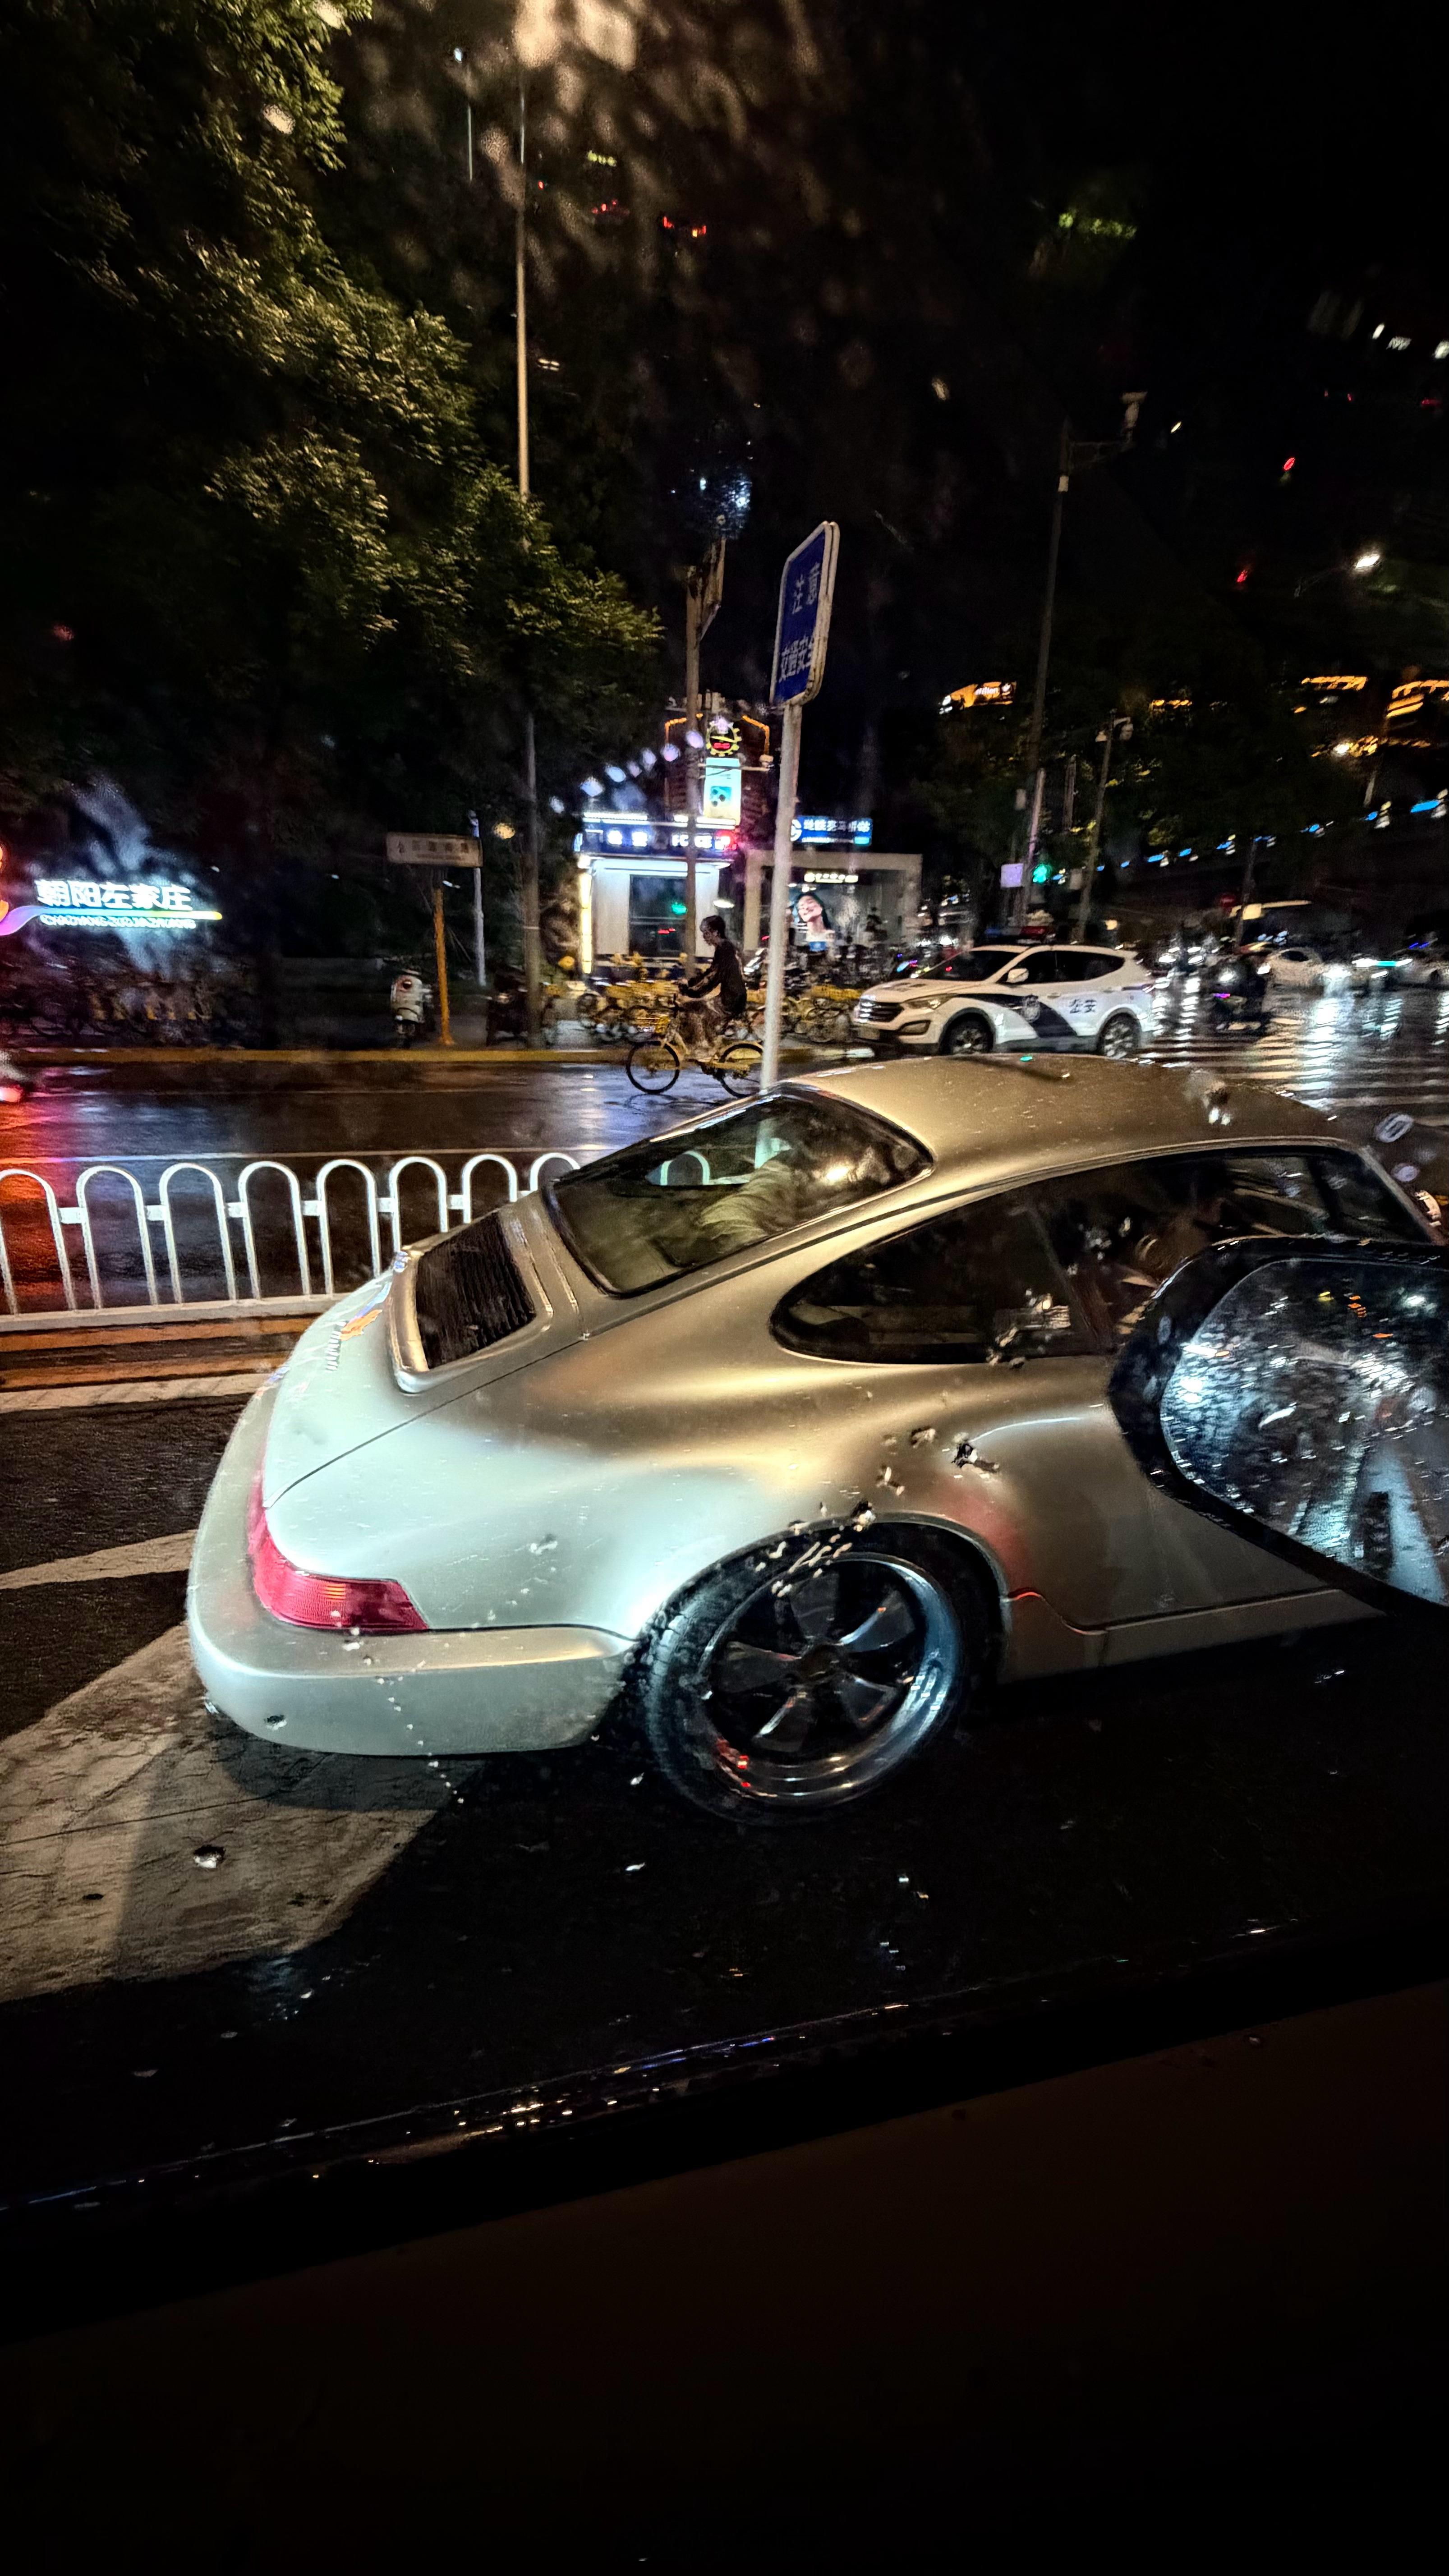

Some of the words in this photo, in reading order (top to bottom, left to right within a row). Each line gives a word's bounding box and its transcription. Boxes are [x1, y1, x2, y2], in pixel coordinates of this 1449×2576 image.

[792, 562, 820, 614] 注意
[35, 879, 193, 911] 朝阳左家庄
[1069, 999, 1096, 1014] 公安
